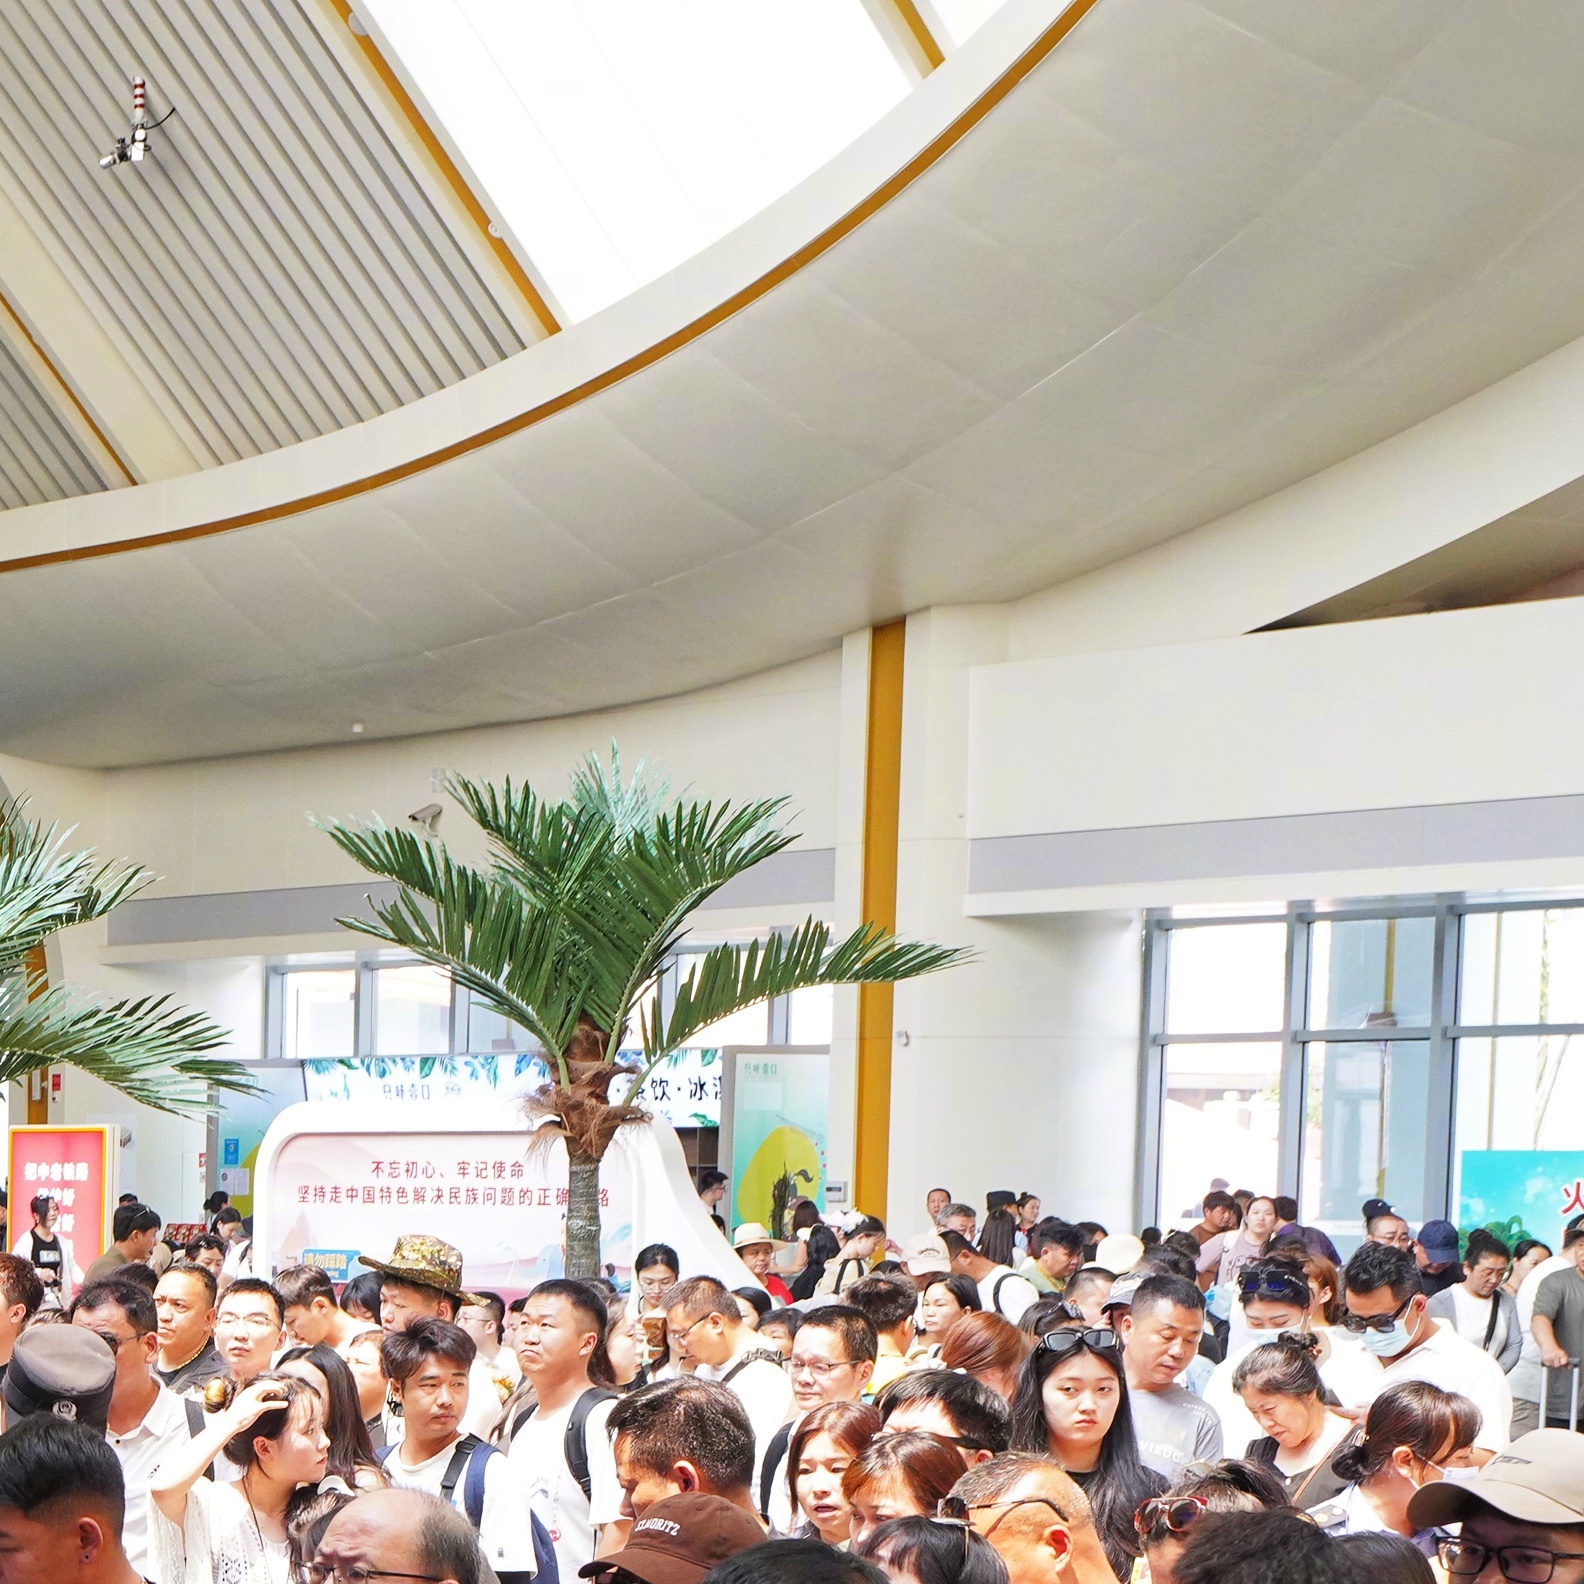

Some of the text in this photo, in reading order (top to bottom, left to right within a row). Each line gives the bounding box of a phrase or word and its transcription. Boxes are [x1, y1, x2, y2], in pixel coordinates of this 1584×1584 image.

[370, 1160, 525, 1180] 不忘初心、牢记使命
[297, 1185, 610, 1208] 坚持走中国特色解决民族问题的正确路
